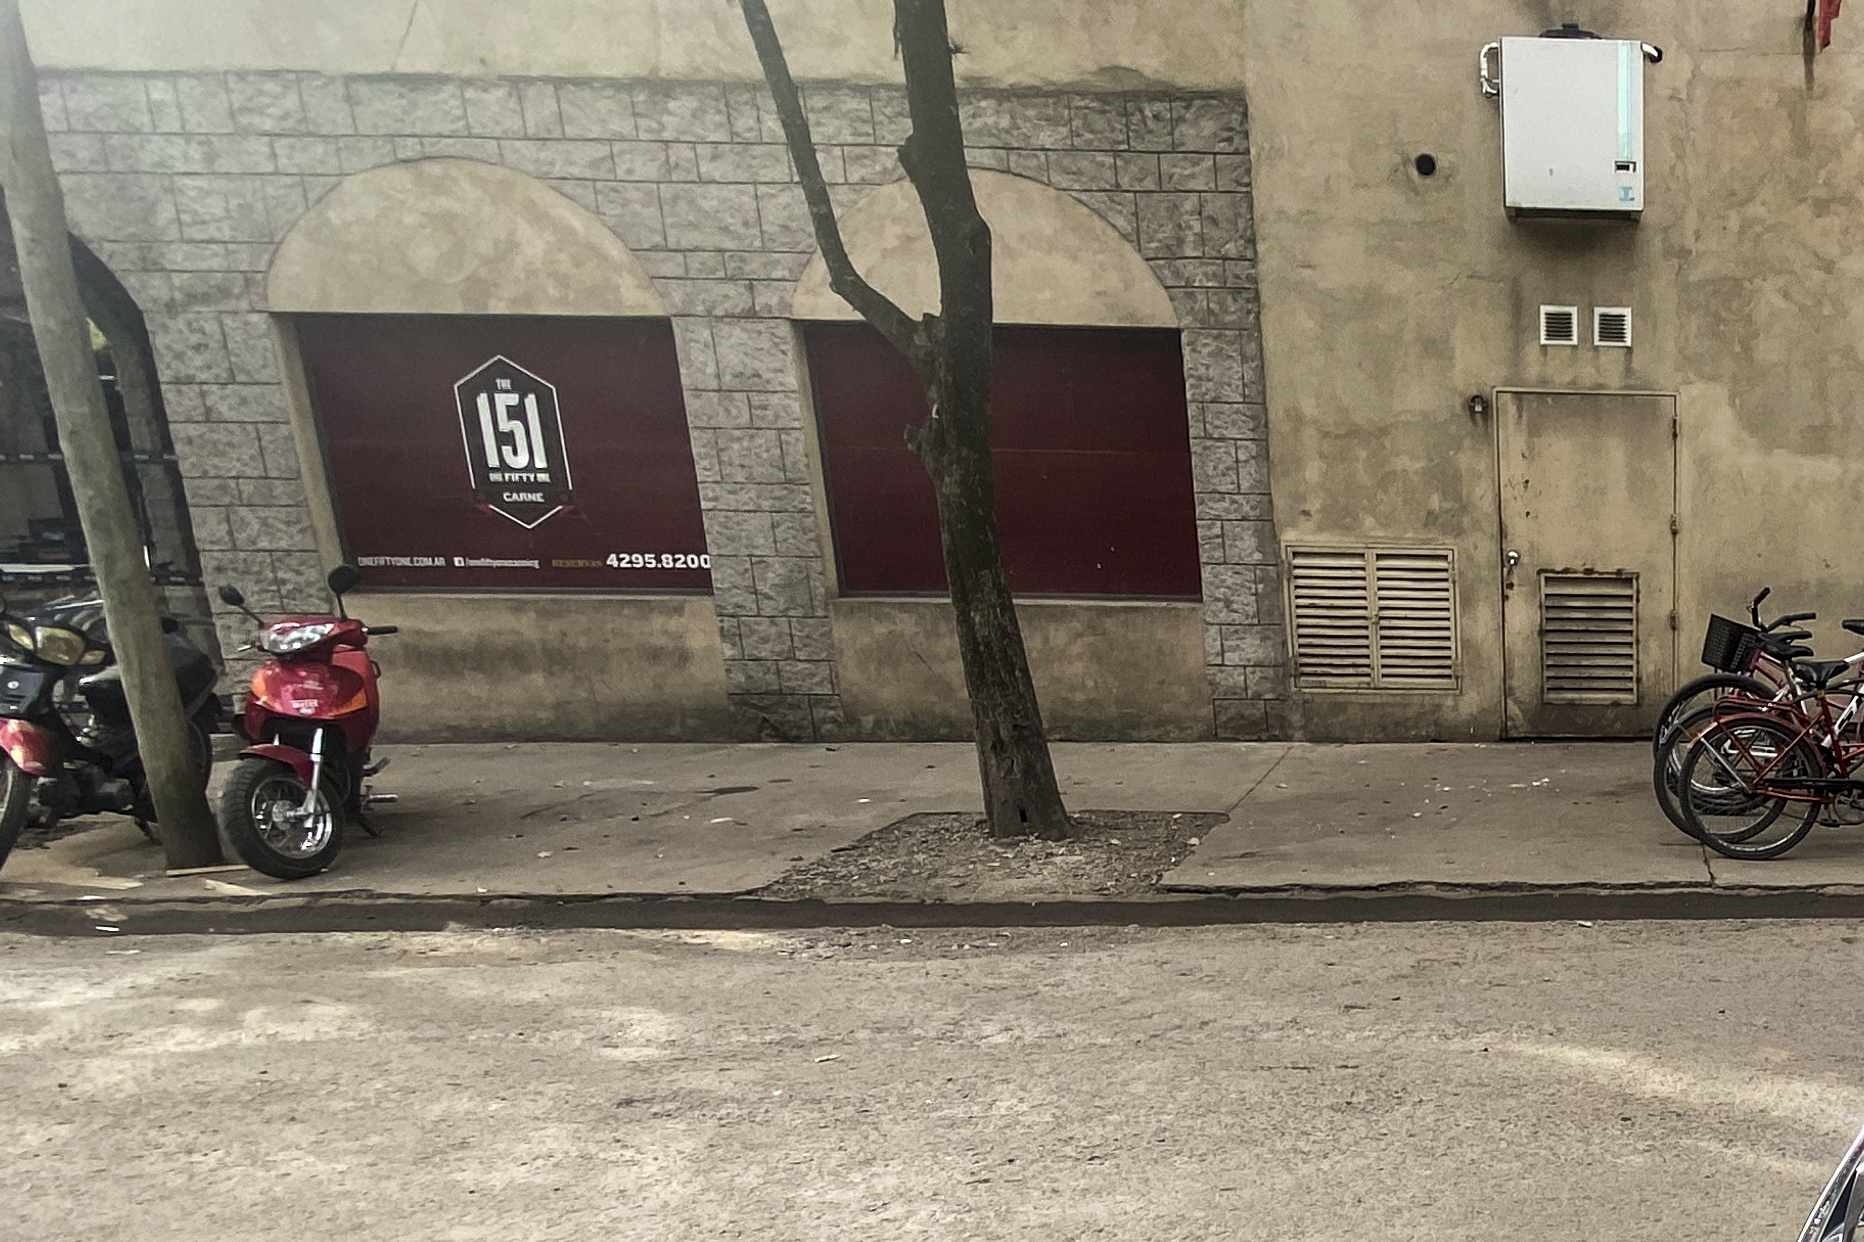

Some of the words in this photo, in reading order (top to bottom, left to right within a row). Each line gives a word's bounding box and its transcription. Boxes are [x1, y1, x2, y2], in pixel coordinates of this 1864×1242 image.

[476, 392, 548, 469] 151
[503, 492, 545, 502] CARNE
[606, 553, 711, 569] 4295.8200
